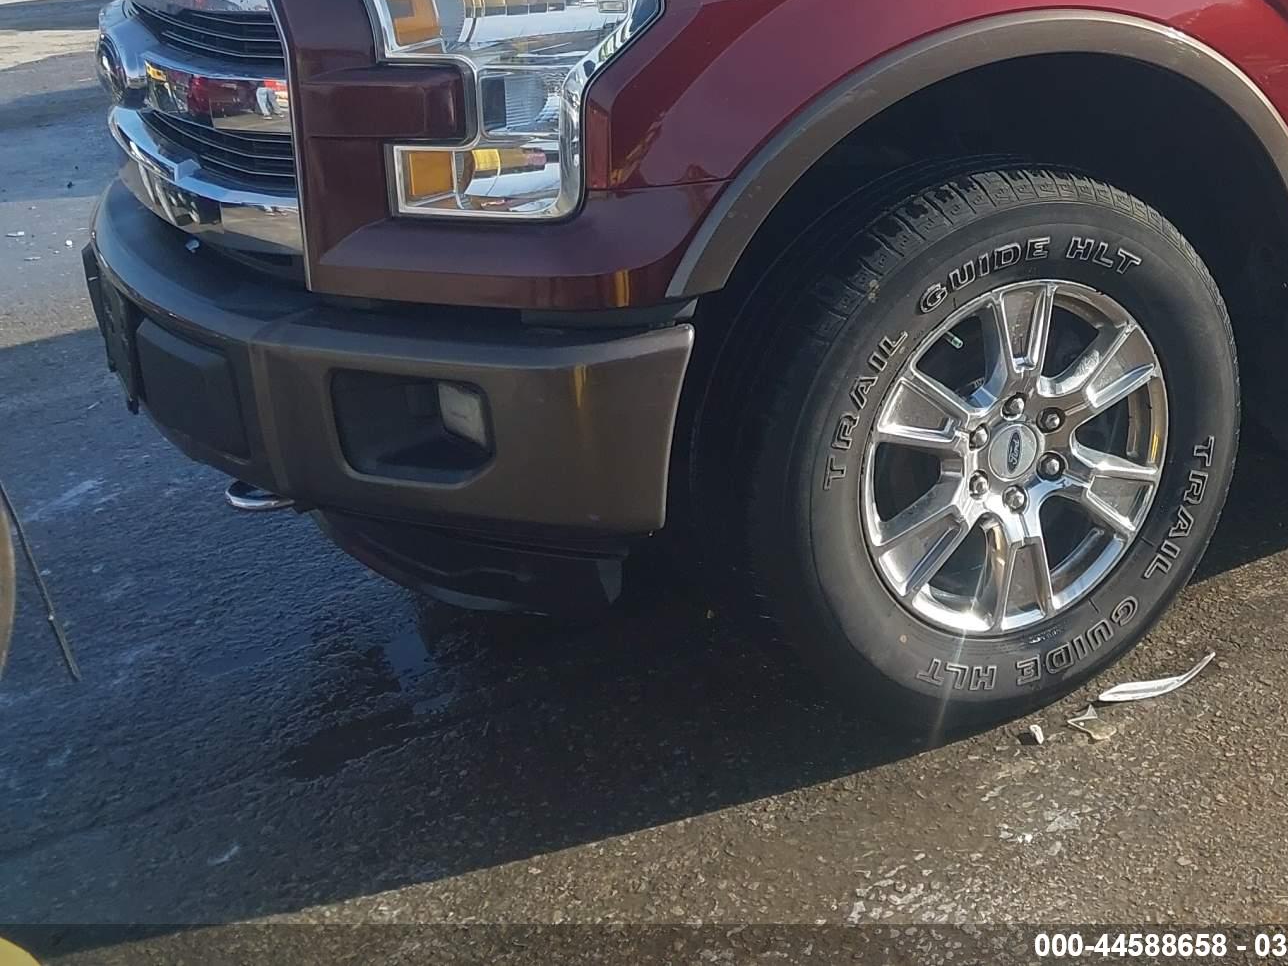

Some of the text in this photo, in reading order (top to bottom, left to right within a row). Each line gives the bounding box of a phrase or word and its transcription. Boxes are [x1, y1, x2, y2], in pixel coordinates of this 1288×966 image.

[823, 236, 1142, 490] TRAIL GUIDE HLT
[916, 436, 1214, 691] TRAIL GUIDE HLT
